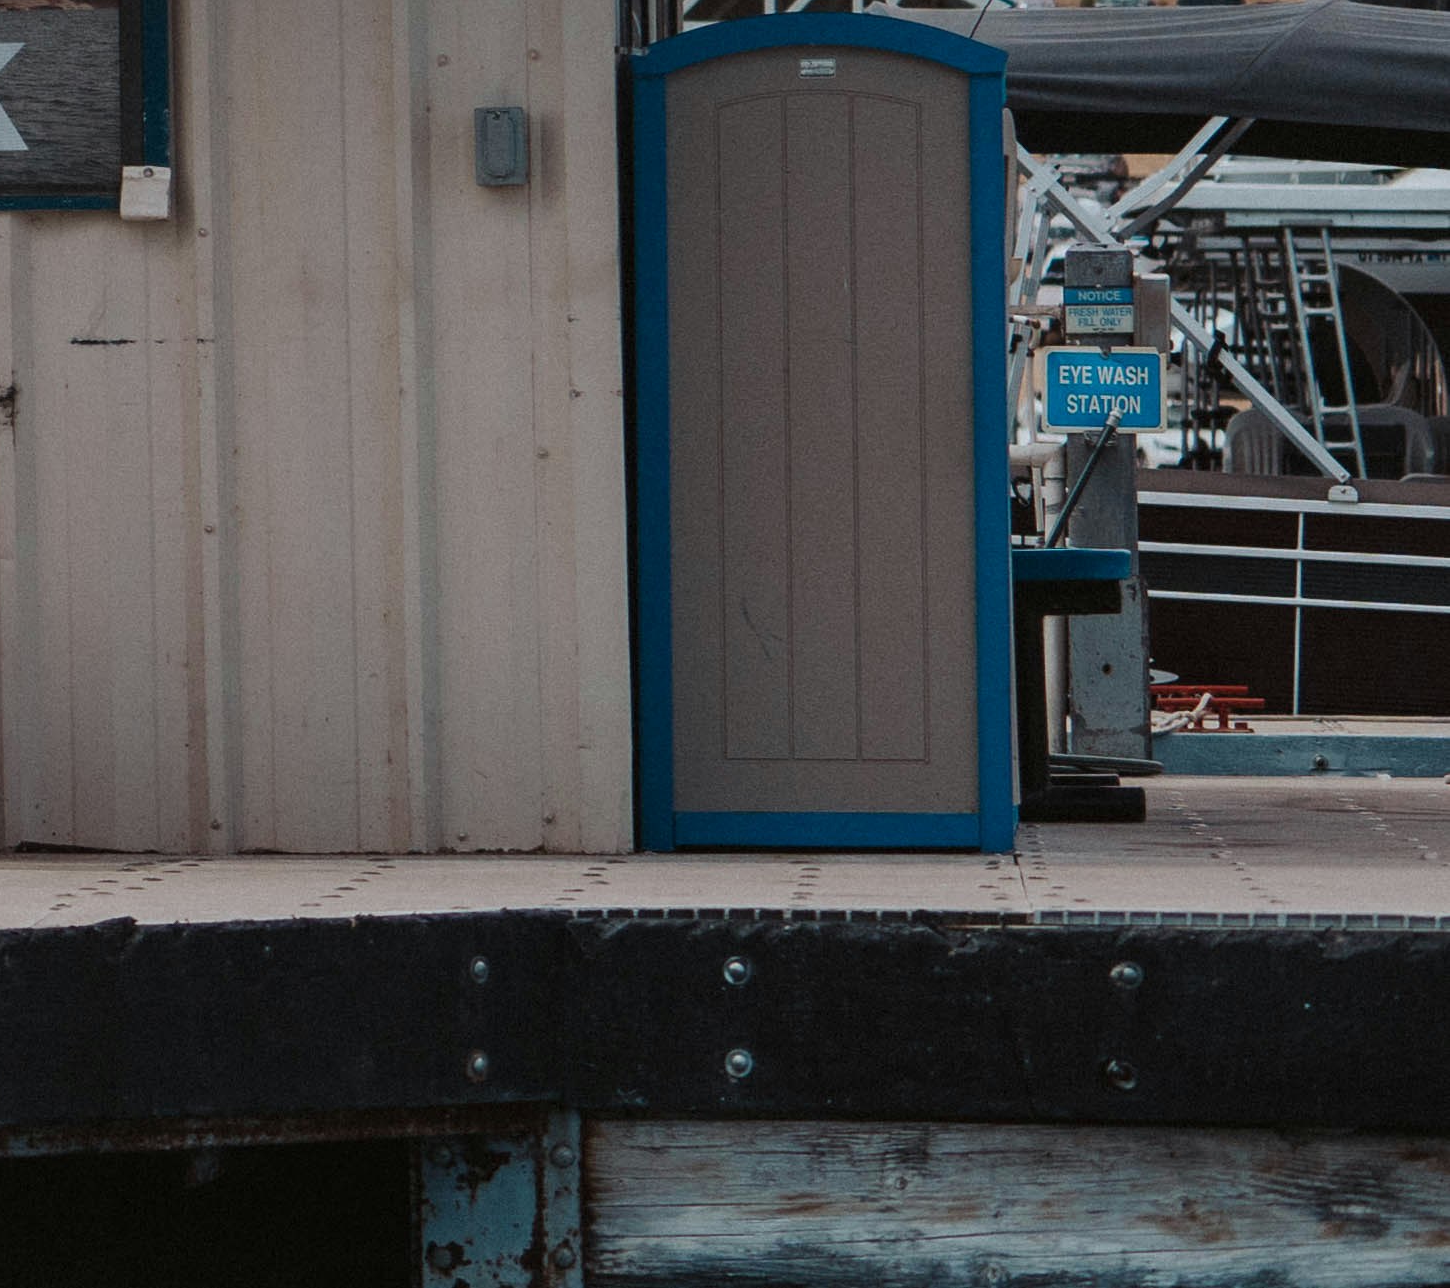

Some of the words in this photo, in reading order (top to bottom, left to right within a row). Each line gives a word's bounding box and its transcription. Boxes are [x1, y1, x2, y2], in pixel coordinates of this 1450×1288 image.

[1078, 291, 1121, 301] NOTICE
[1068, 307, 1099, 315] FRESH
[1102, 307, 1132, 315] WATER
[1078, 317, 1097, 327] FILL
[1099, 317, 1121, 327] ONLY
[1059, 365, 1093, 384] EYE
[1097, 366, 1148, 385] WASH
[1067, 394, 1140, 415] STATION
